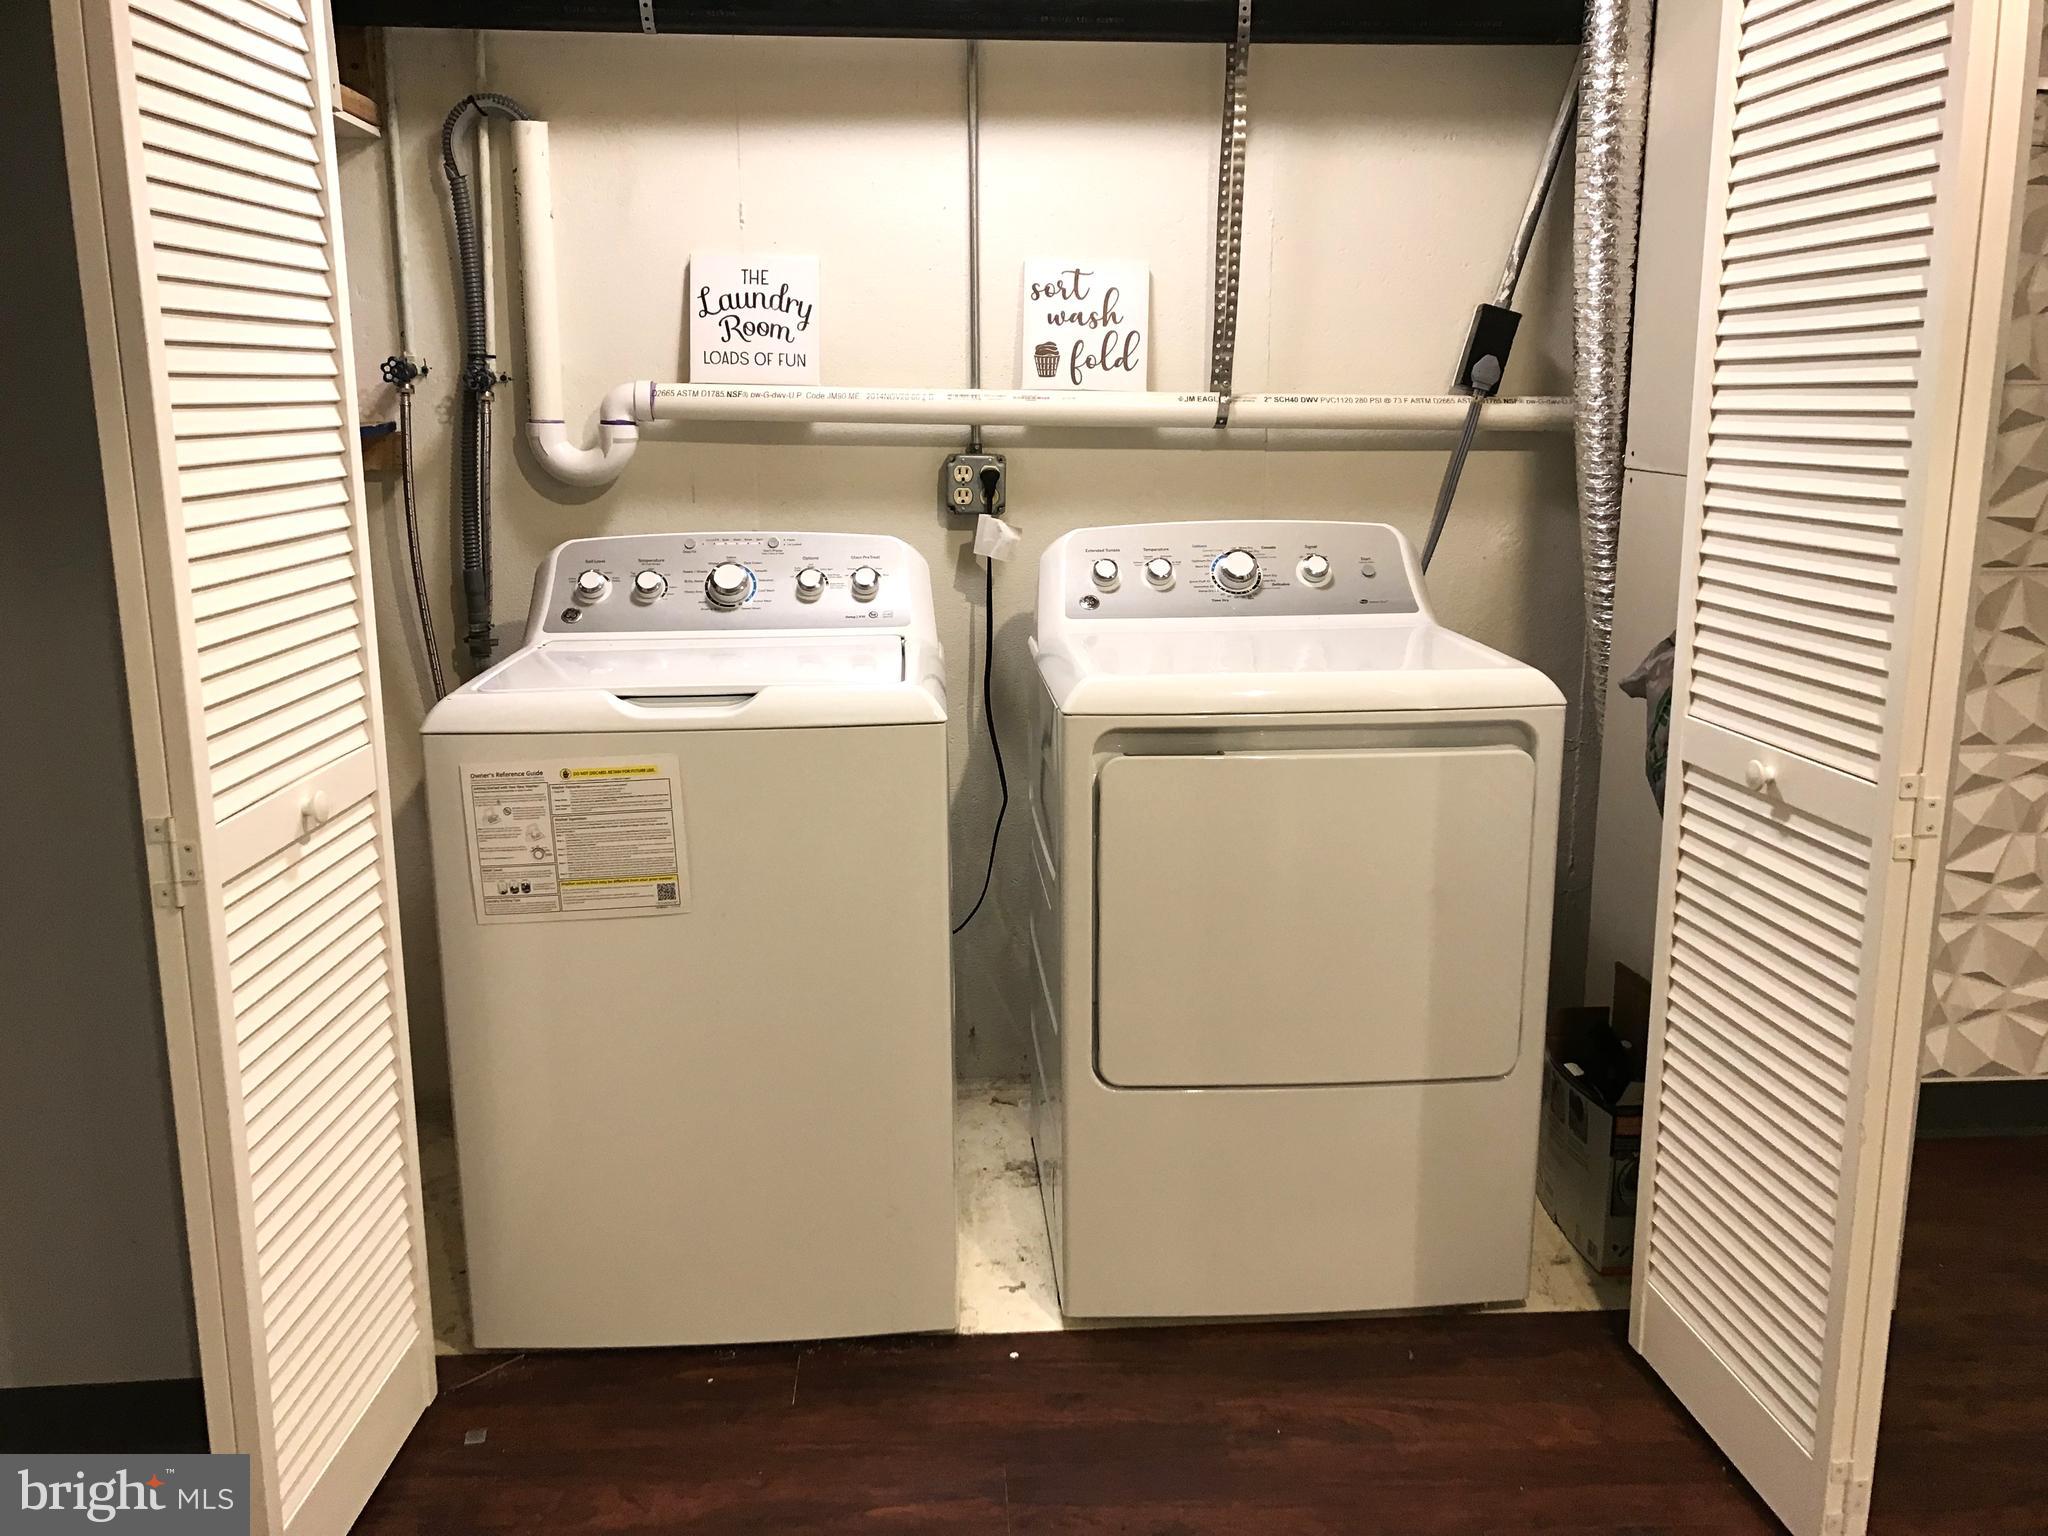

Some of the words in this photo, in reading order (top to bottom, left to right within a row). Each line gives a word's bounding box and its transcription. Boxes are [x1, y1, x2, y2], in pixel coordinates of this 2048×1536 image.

[741, 269, 769, 285] THE
[1031, 268, 1094, 301] sort
[697, 283, 812, 331] Laundry
[1047, 287, 1124, 329] wash
[718, 314, 795, 343] Room
[703, 350, 750, 365] LOADS
[754, 352, 773, 366] OF
[778, 352, 806, 367] FUN
[1070, 330, 1141, 385] fold
[806, 392, 825, 400] Code
